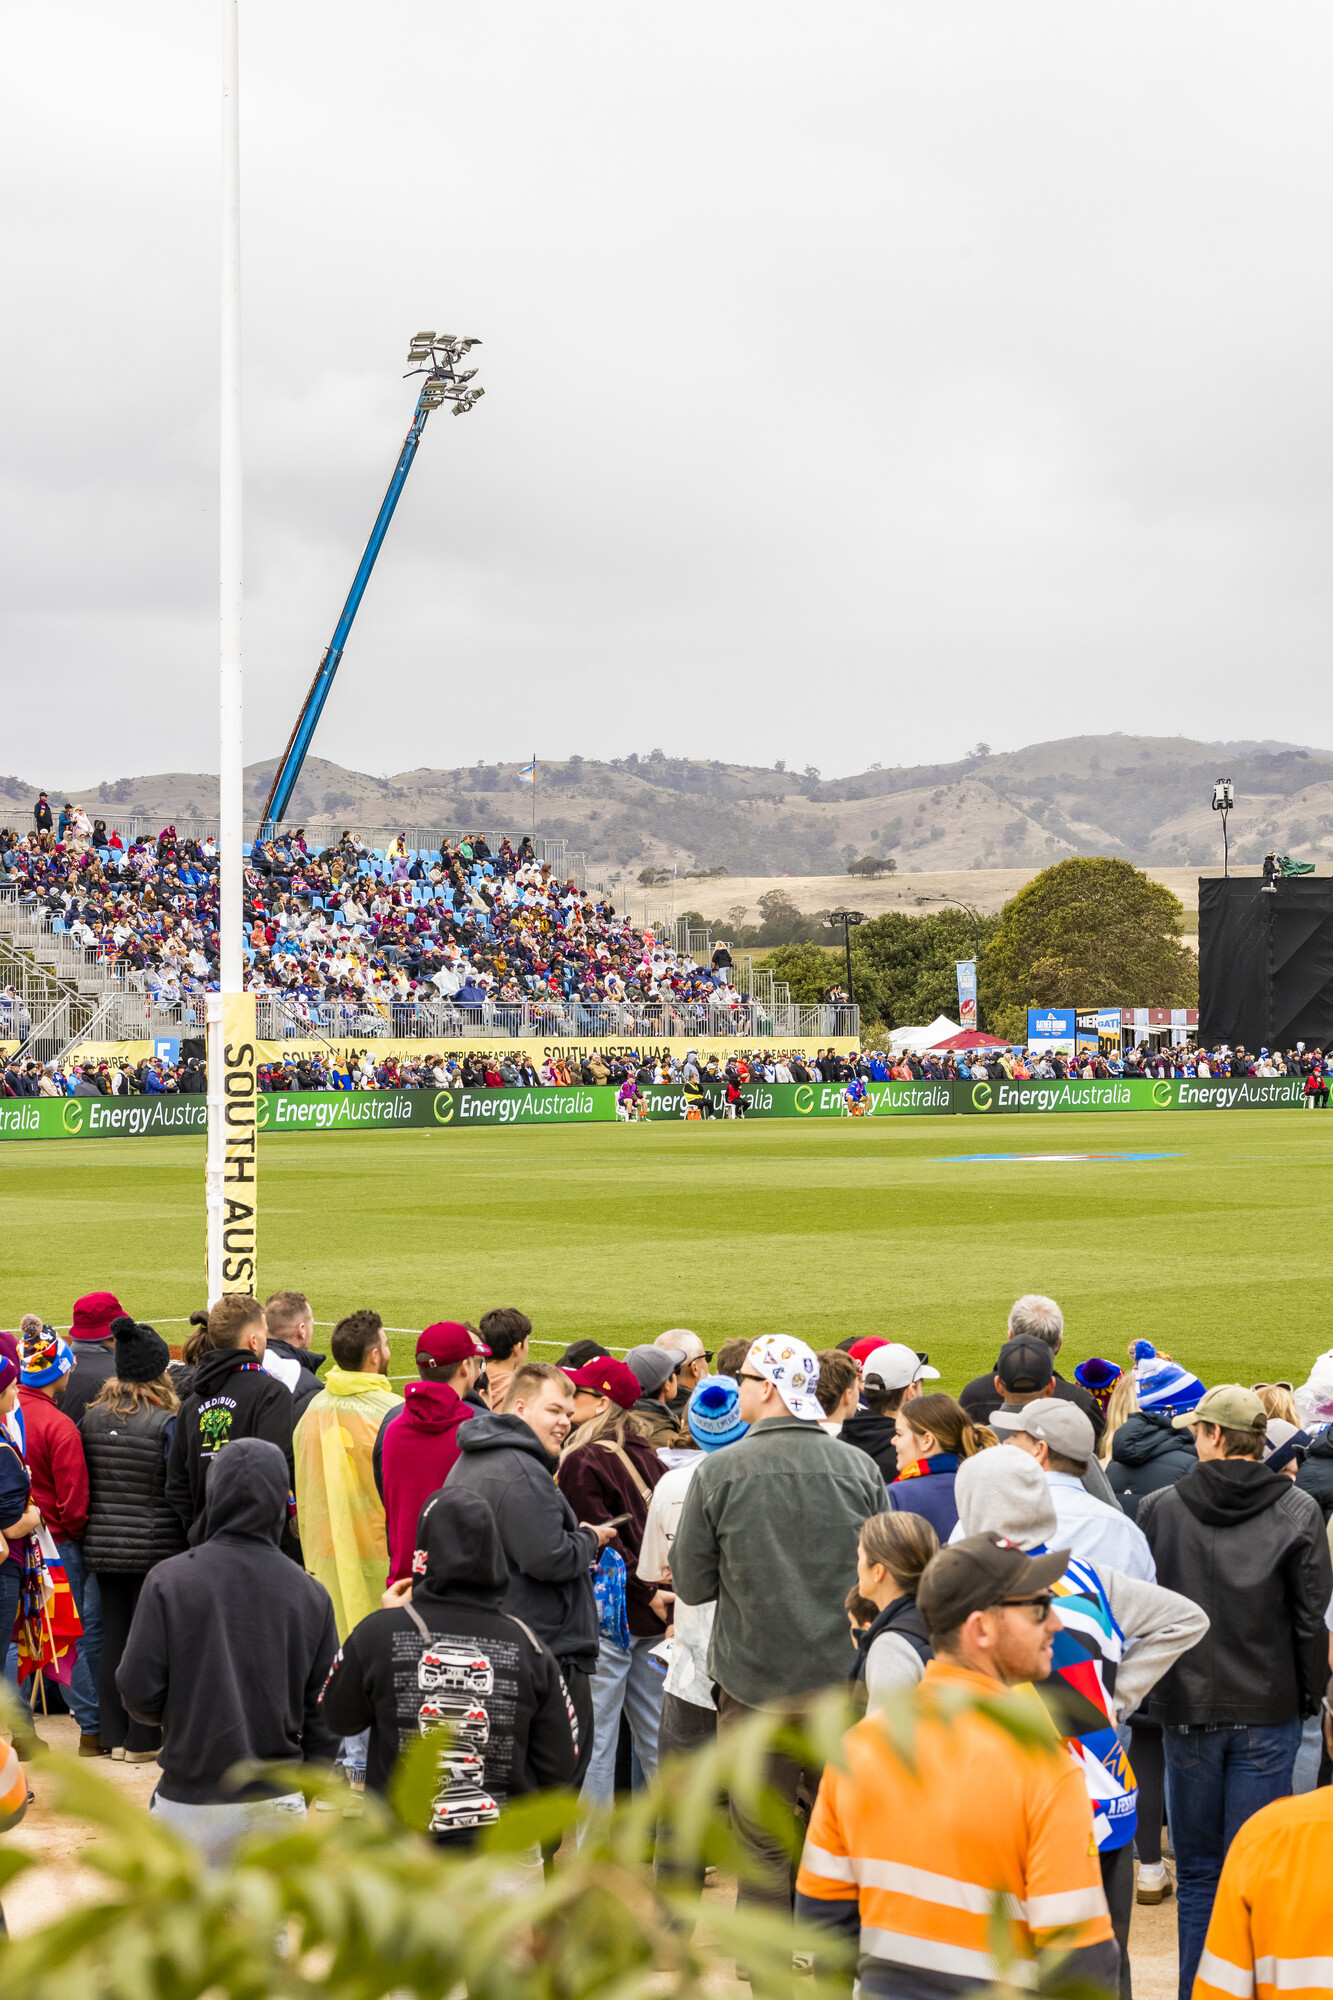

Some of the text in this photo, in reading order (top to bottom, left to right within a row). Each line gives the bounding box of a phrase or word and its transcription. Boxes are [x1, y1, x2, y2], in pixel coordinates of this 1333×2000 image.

[460, 1091, 593, 1121] EnergyAustralia
[820, 1085, 950, 1113] EnyAustralia
[998, 1083, 1131, 1110] EnergyAustralia
[223, 1043, 255, 1182] SOUTH
[275, 1096, 412, 1127] EnergyAustralia
[197, 1396, 237, 1414] MEDIBUD
